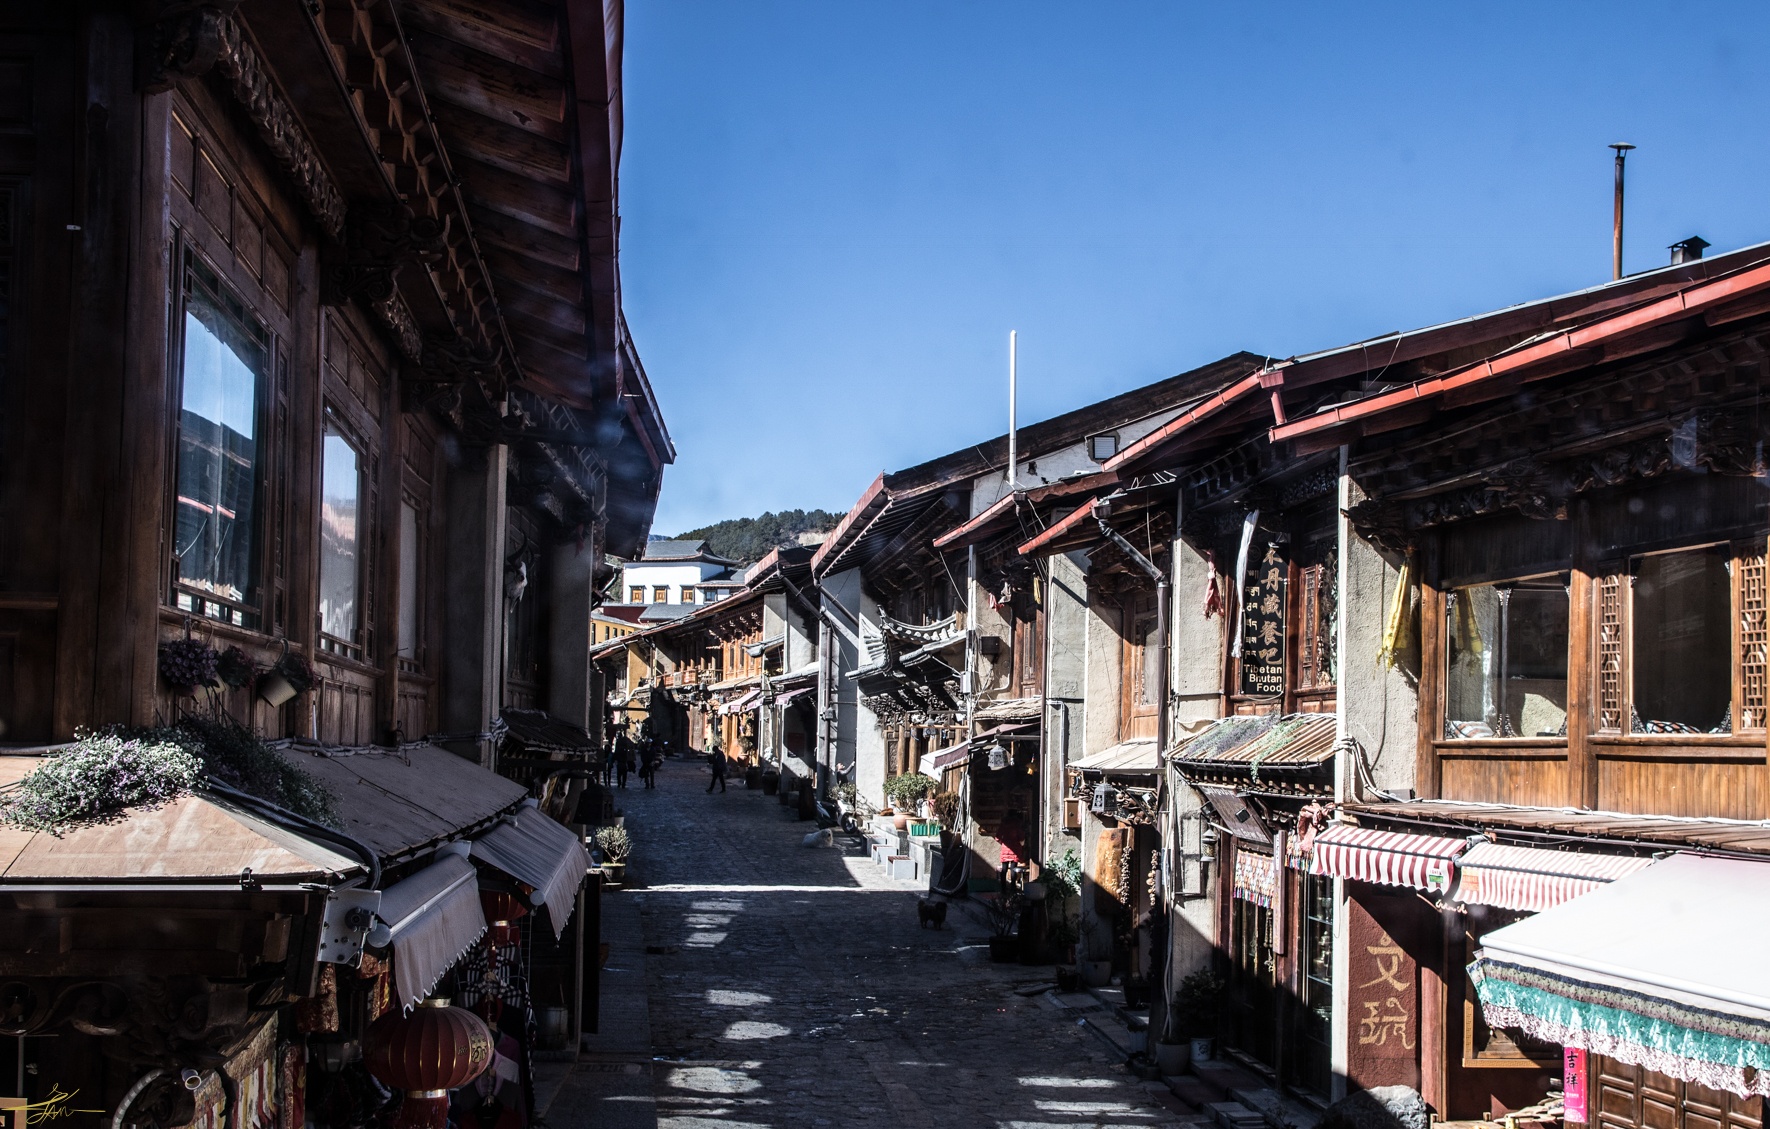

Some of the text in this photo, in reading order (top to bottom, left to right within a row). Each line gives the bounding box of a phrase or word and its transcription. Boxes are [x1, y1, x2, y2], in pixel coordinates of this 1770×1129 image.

[1244, 665, 1282, 673] Tibetan
[1257, 683, 1282, 691] Food
[1566, 1050, 1578, 1091] 吉祥
